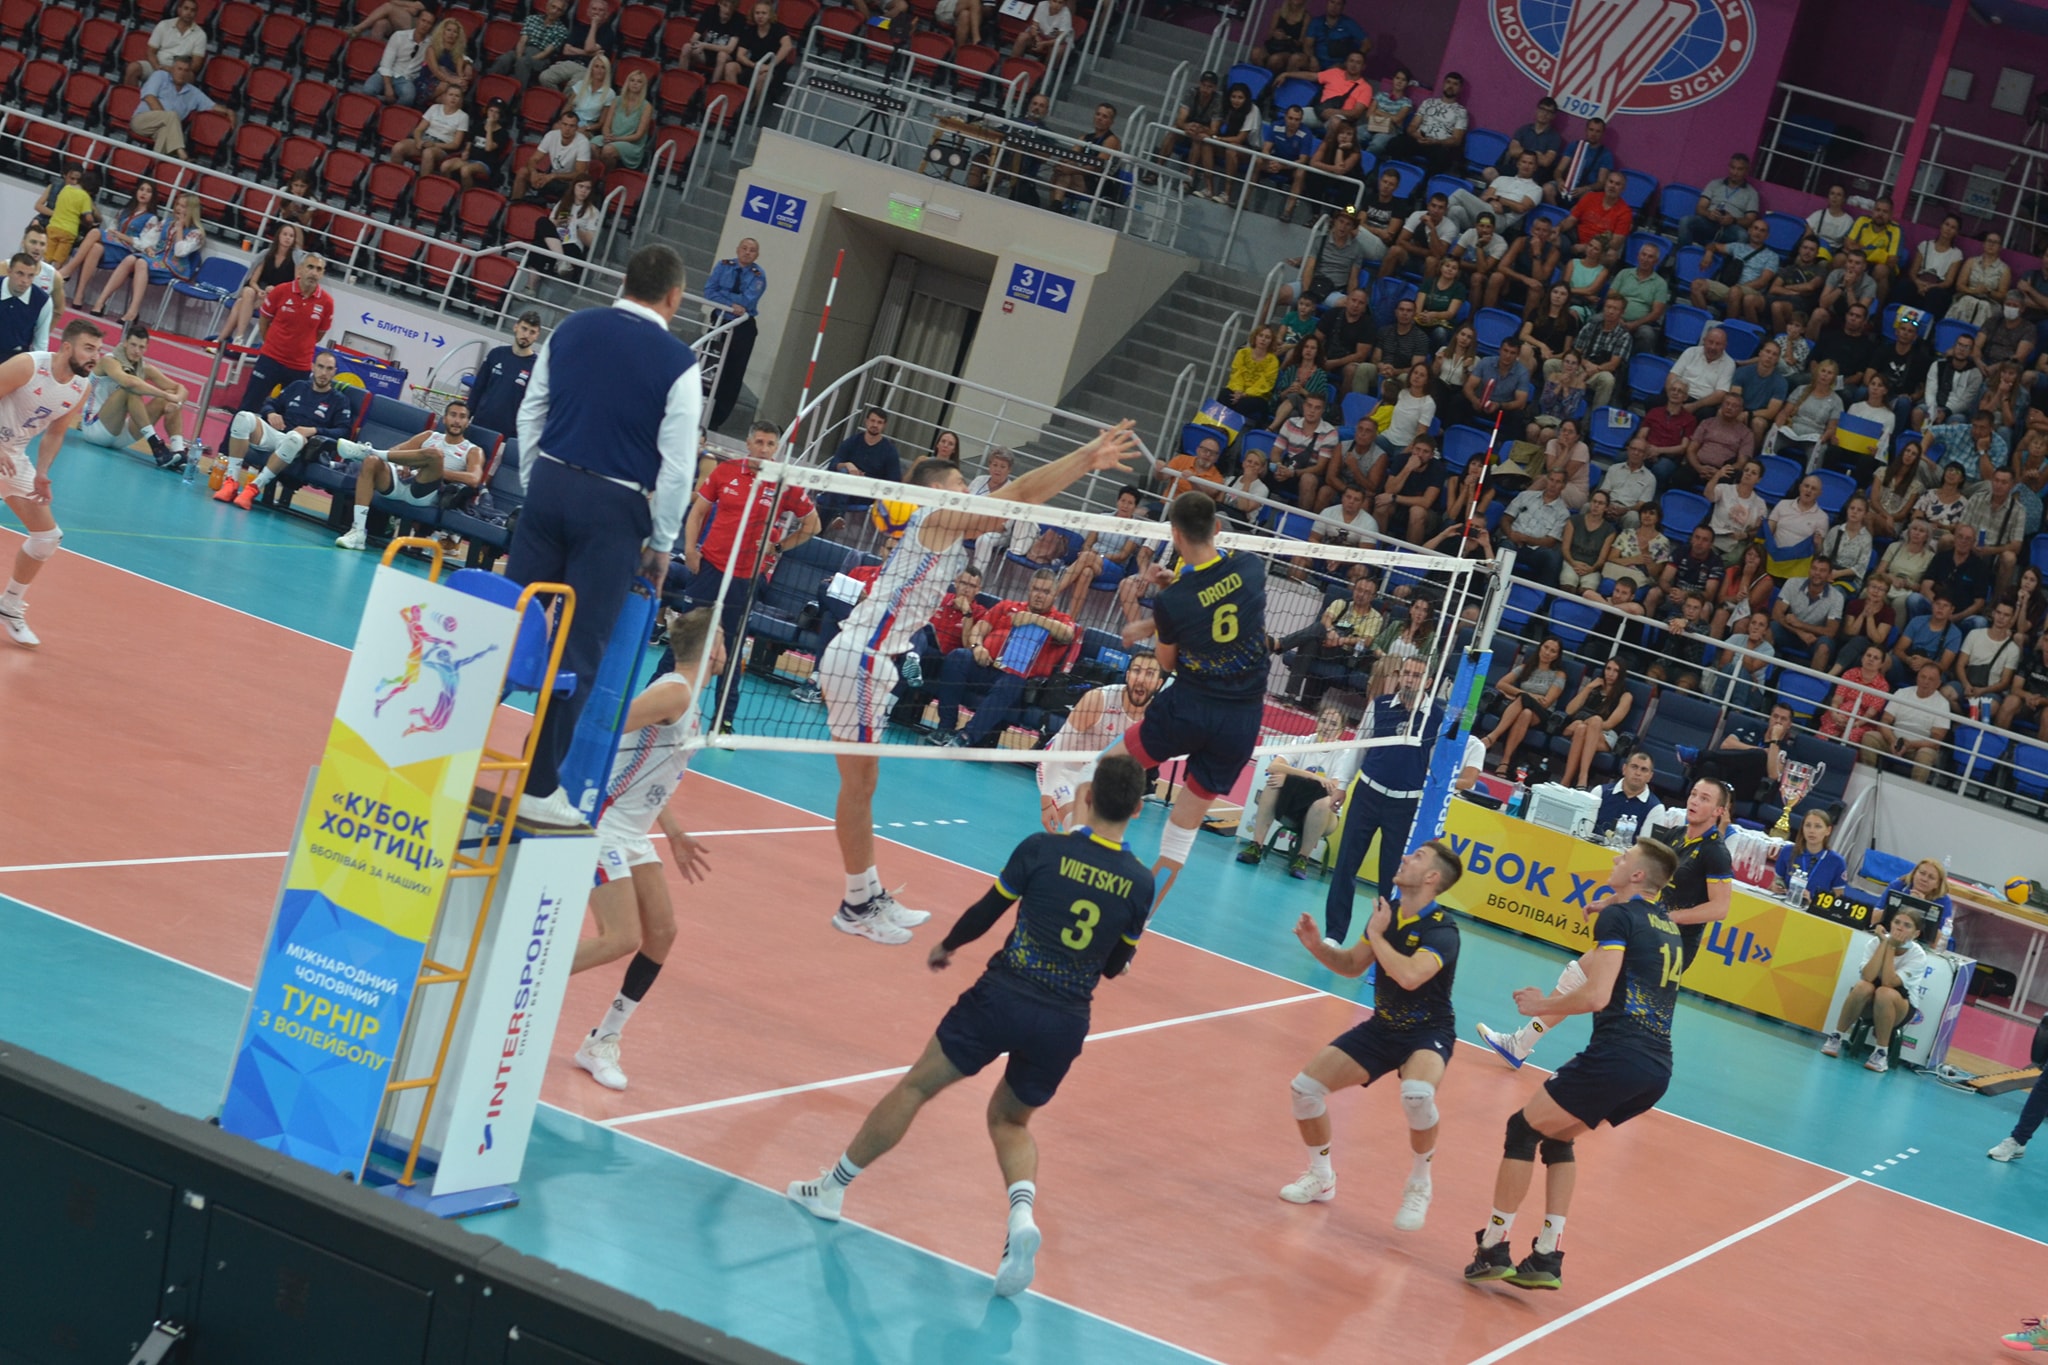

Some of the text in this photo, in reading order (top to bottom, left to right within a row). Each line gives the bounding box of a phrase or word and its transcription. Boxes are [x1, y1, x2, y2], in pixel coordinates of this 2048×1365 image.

[1500, 6, 1725, 100] MOTOR SICH
[1562, 97, 1600, 117] 1907
[783, 199, 798, 216] 2
[1020, 269, 1034, 286] 3
[377, 320, 429, 342] БЛИТЧЕР 1
[22, 406, 52, 429] 2
[1197, 572, 1243, 607] DROZD
[1212, 603, 1239, 643] 6
[332, 792, 429, 840] «КУБОК
[319, 810, 444, 871] ХОРТИЦІ»
[310, 843, 432, 896] ВБОЛІВАЙ ЗА НАШИХ!
[1059, 856, 1133, 899] VIIETSKYI
[1440, 831, 1555, 897] УБОК
[1061, 899, 1100, 950] 3
[1487, 893, 1590, 938] ВБОЛІВАЙ ЗА
[1816, 893, 1834, 908] 19
[1834, 899, 1842, 907] 0
[1844, 902, 1851, 910] 1
[1850, 904, 1867, 920] 19
[285, 943, 399, 996] МІЖНАРОДНИЙ
[295, 965, 380, 1008] ЧОЛОВІЧИЙ
[1659, 942, 1683, 991] 14
[282, 984, 380, 1040] ТУРНІР
[487, 891, 553, 1118] INTERSPORT
[258, 1010, 387, 1071] З ВОЛЕЙБОЛУ
